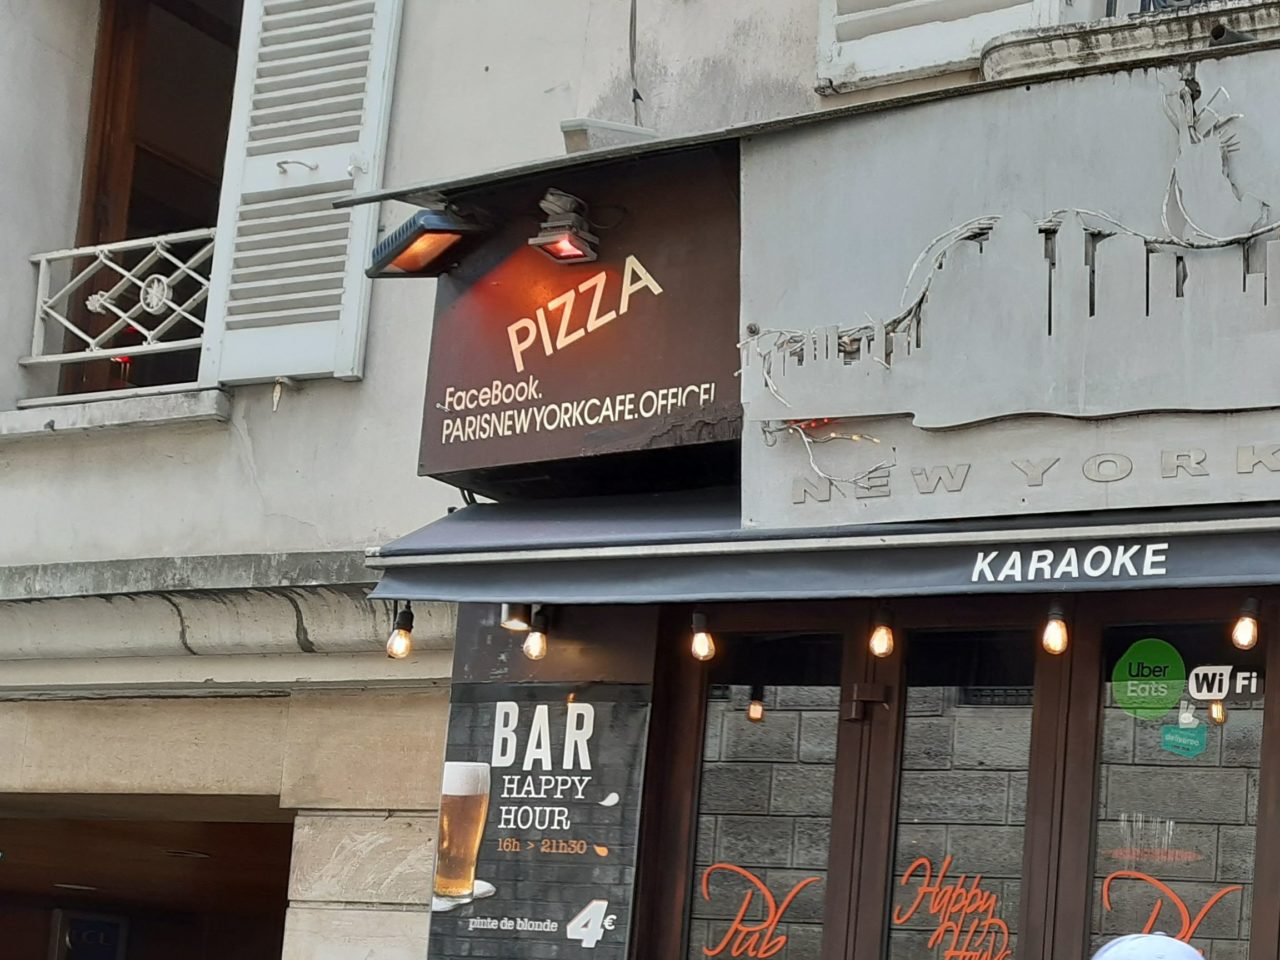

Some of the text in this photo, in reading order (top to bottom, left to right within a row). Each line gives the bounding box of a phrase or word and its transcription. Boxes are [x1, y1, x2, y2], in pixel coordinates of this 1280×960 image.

[507, 254, 663, 373] PIZZA
[792, 461, 972, 504] NEW
[970, 542, 1170, 583] KARAOKE
[1128, 661, 1170, 678] Uber
[1126, 680, 1169, 697] Eats
[491, 701, 595, 771] BAR
[501, 775, 592, 801] HAPPY
[497, 805, 571, 831] HOUR
[497, 837, 521, 852] 16h
[540, 838, 588, 855] 21h30
[702, 863, 822, 958] Pub
[468, 916, 559, 932] pinte de blonde
